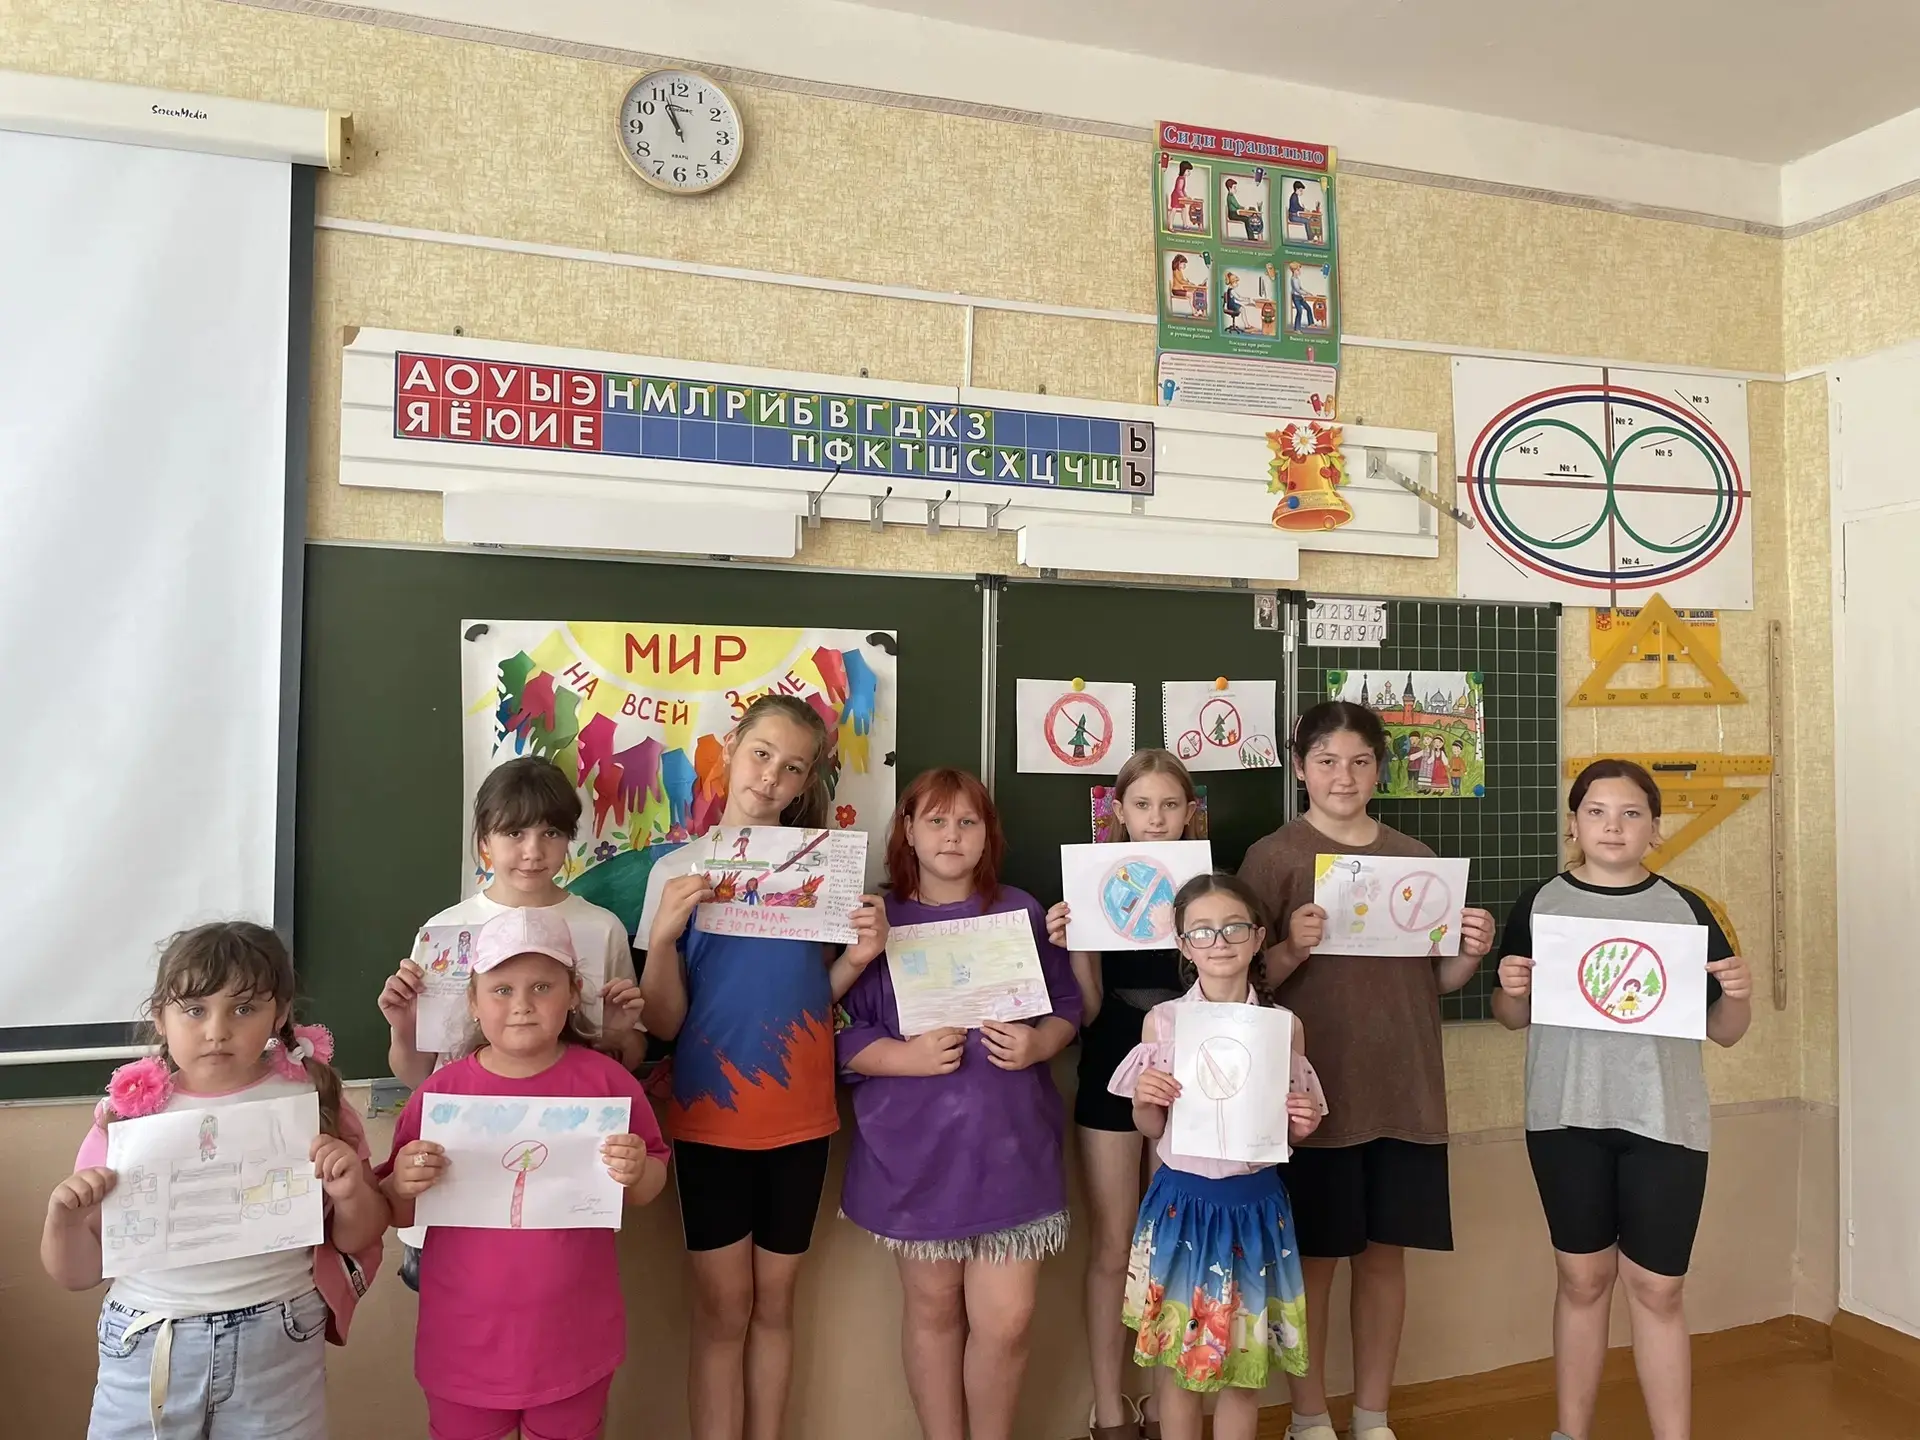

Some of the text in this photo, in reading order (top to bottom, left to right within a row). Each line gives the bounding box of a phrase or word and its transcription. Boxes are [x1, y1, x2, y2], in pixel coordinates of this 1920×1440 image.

[652, 87, 665, 102] 11
[670, 82, 689, 98] 12
[697, 91, 704, 105] 1
[151, 104, 208, 120] ScreenMedia
[636, 101, 655, 116] 10
[709, 107, 722, 123] 2
[629, 119, 644, 135] 9
[716, 130, 730, 146] 3
[1163, 125, 1325, 165] Сиди правильно
[636, 140, 651, 158] 8
[710, 150, 724, 165] 4
[652, 160, 665, 175] 7
[672, 166, 687, 183] 6
[695, 163, 709, 180] 5
[402, 361, 1148, 454] А О У Ы Э Н М Л Р Й Б В Г Д Ж З Ь
[1704, 395, 1710, 405] 3
[1628, 417, 1634, 426] 2
[404, 400, 1147, 490] Я Ё Ю И Е П Ф К Т Ш С Х Ц Ч Щ Ъ
[1533, 446, 1539, 455] 5
[1667, 449, 1673, 457] 5
[1572, 464, 1577, 473] 1
[1634, 557, 1640, 566] 4
[1316, 603, 1382, 623] 1 2 3 4 5
[1689, 609, 1715, 619] ШКОЛЕ
[1315, 622, 1384, 641] 6 7 8 9 10
[625, 633, 747, 676] МИР
[563, 661, 599, 700] НА
[621, 693, 688, 726] ВСЕЙ
[1678, 793, 1750, 802] 30 40 50
[724, 906, 790, 925] ПРАВИЛА
[703, 917, 820, 939] БЕЗОПАСНОСТИ
